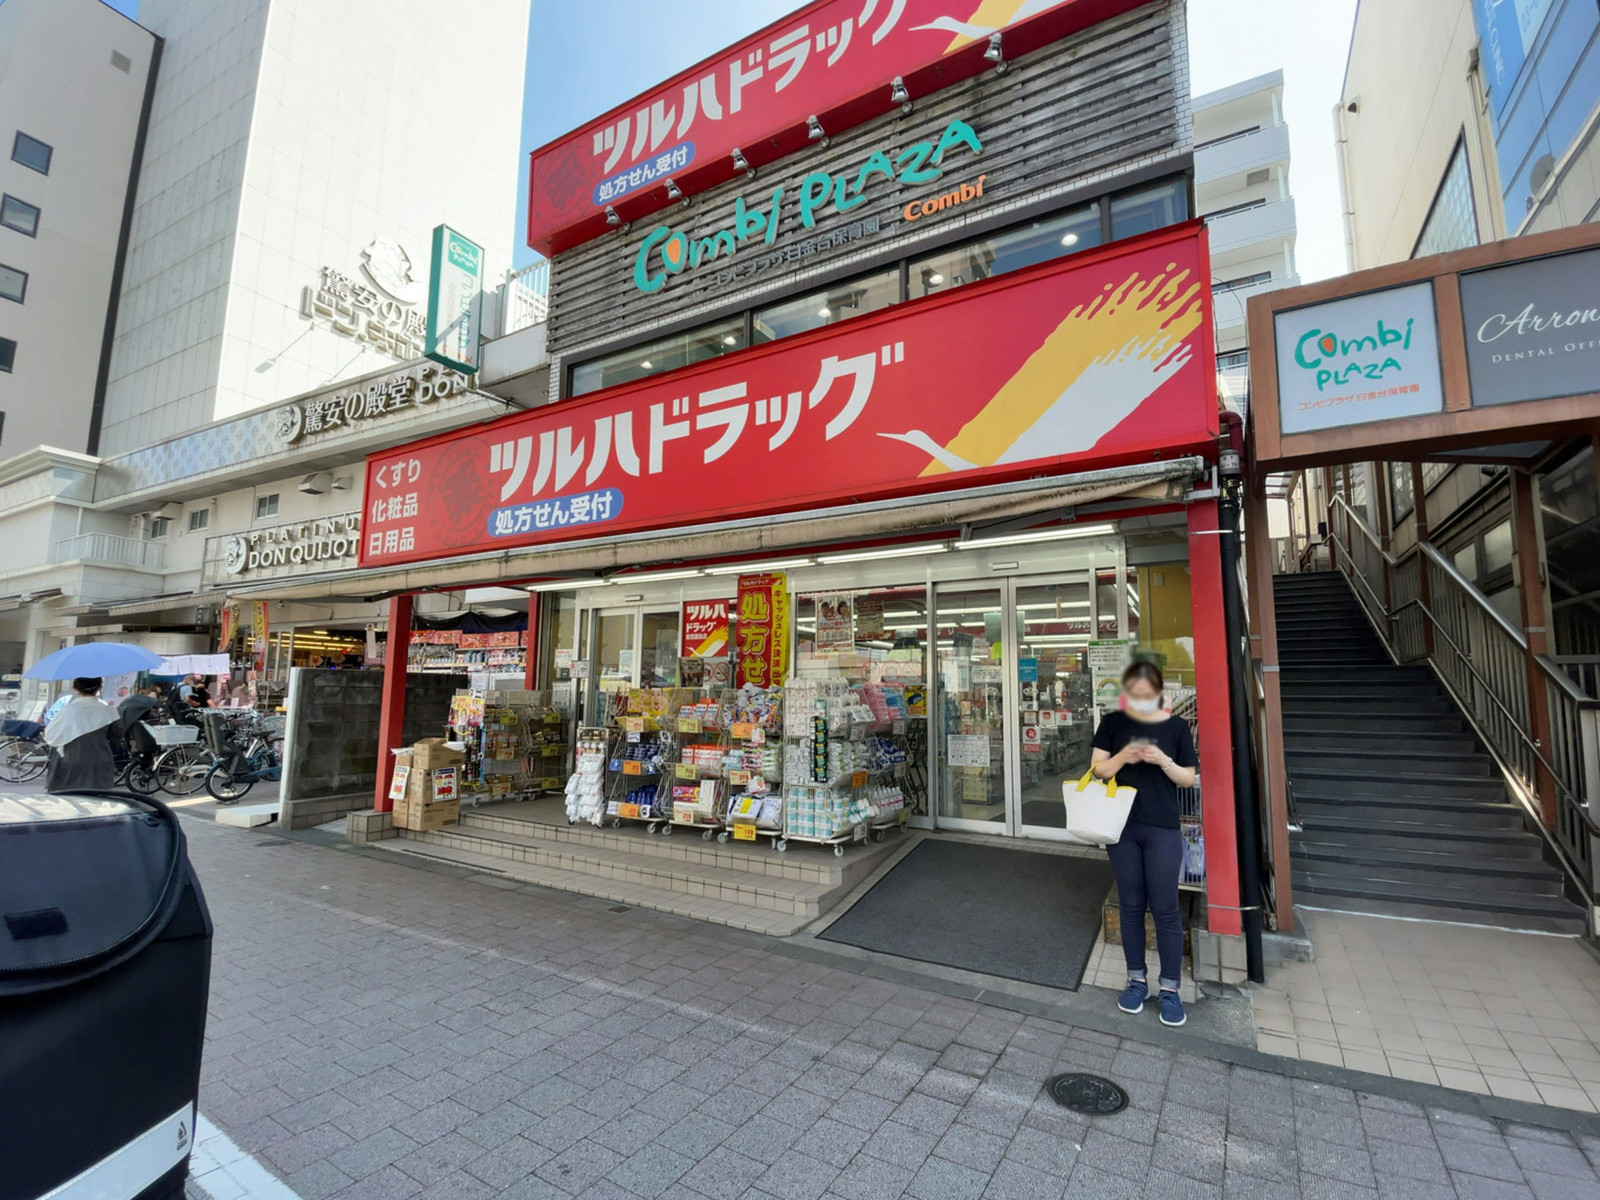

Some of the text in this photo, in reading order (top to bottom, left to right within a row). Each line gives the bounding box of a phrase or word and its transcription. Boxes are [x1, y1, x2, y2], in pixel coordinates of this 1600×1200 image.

[598, 146, 688, 202] 処方せん受付
[634, 187, 784, 293] Combi
[800, 120, 983, 229] PLAZA
[903, 175, 987, 221] Combi
[1295, 317, 1414, 369] Combi
[1491, 340, 1600, 364] DENTAL OFF
[1316, 357, 1402, 391] PLAZA
[303, 376, 412, 435] 驚安の殿堂
[489, 342, 905, 502] ツルハドラッグ
[375, 459, 421, 489] くすり
[371, 492, 418, 524] 化粧品
[494, 490, 612, 535] 処方せん受付
[248, 546, 287, 569] DON
[368, 526, 415, 556] 日用品
[685, 621, 717, 633] ドラッグ
[686, 603, 727, 621] ツルハ
